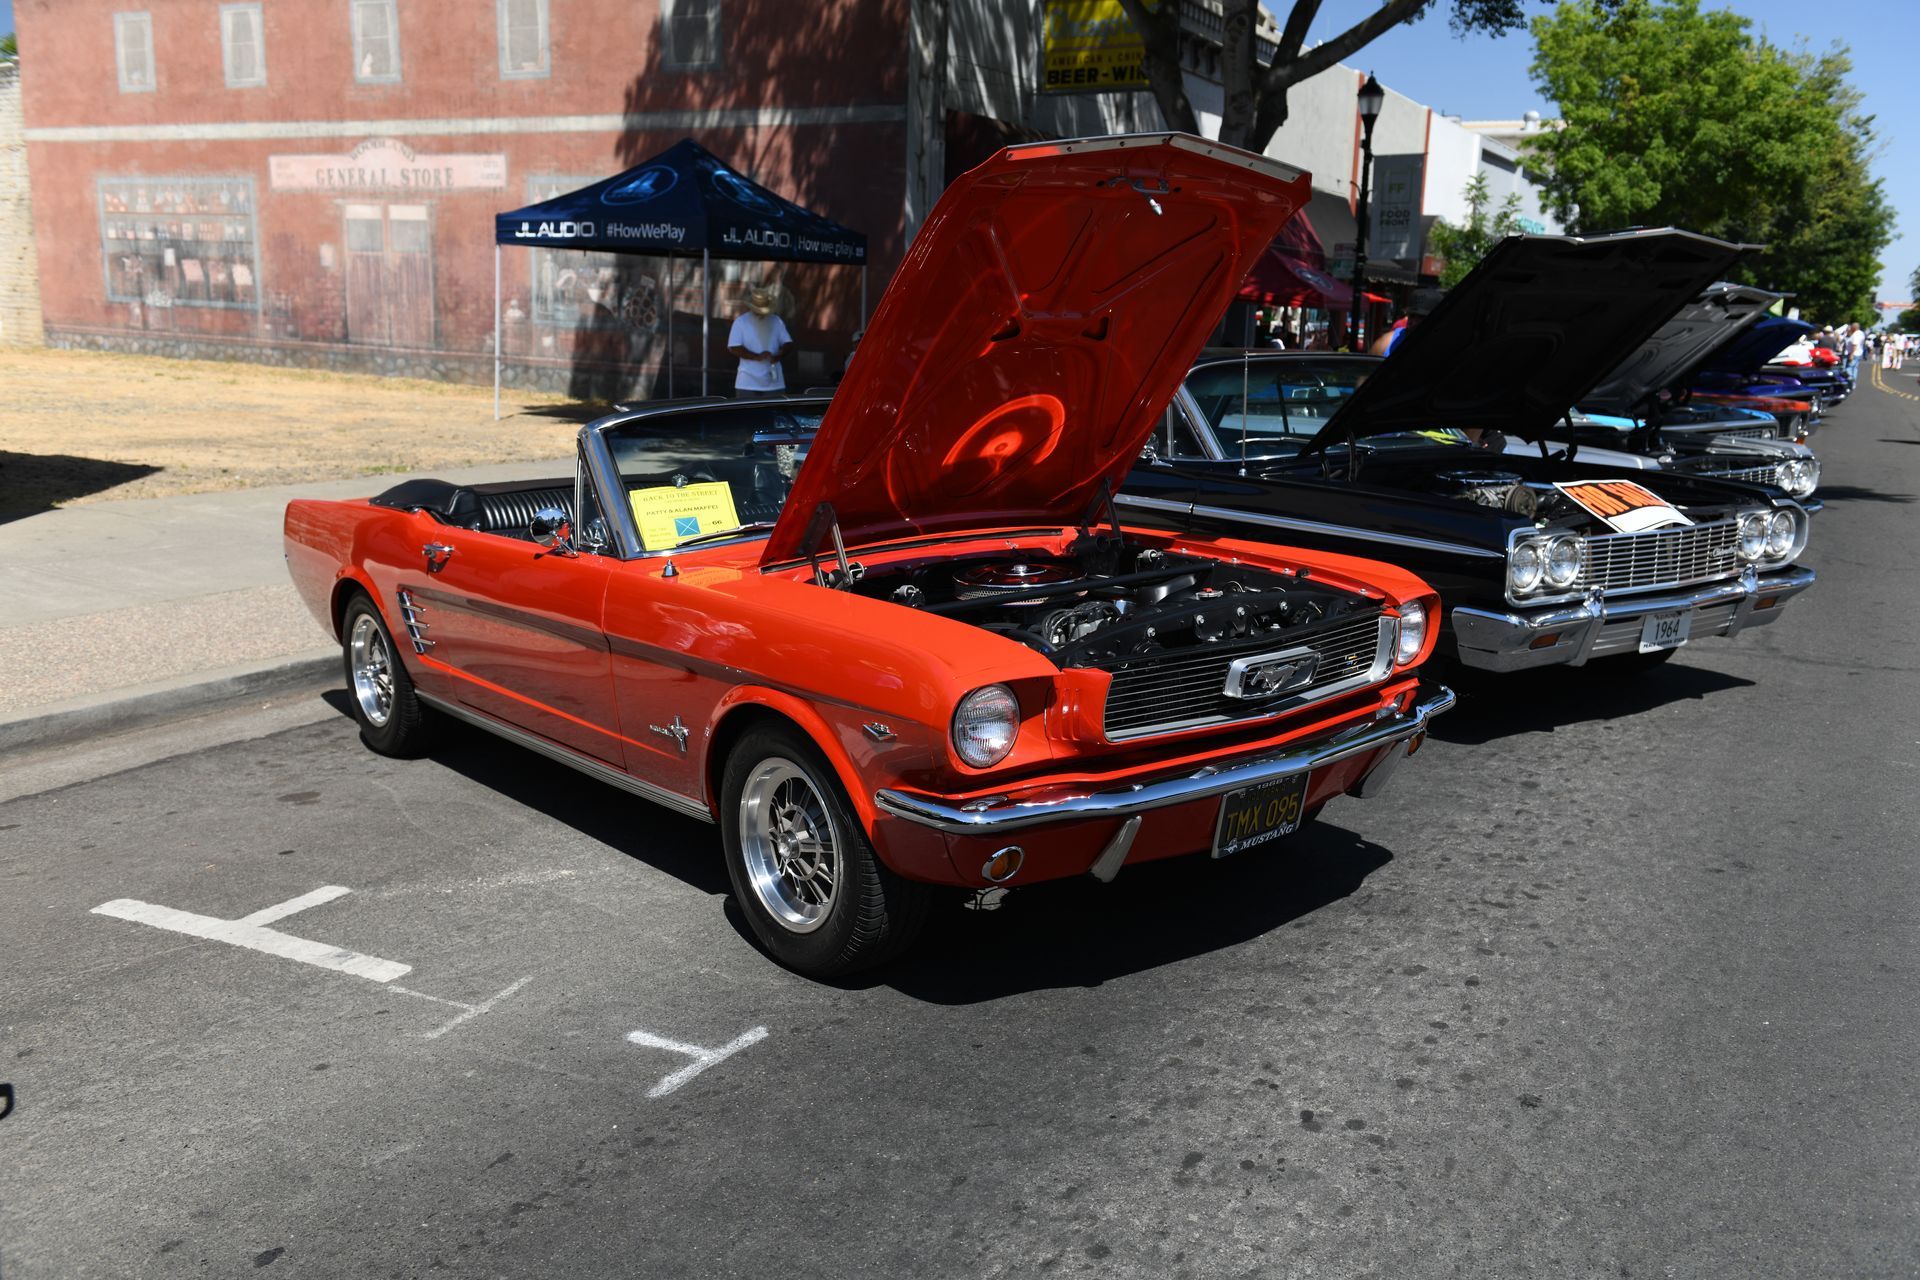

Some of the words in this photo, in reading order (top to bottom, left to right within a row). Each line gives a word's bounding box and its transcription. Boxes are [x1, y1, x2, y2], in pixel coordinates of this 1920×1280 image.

[1047, 67, 1098, 85] BEER
[1112, 65, 1147, 82] WIN
[316, 167, 391, 187] GENERAL
[400, 167, 454, 187] STORE
[1380, 209, 1410, 218] FOOD
[1380, 219, 1410, 227] FRONT
[537, 221, 596, 238] AUDIO
[606, 222, 686, 243] #HowWePlay
[743, 228, 791, 248] AUDIO
[798, 235, 820, 252] How
[821, 242, 834, 254] we
[643, 494, 664, 502] BACK
[1655, 619, 1680, 640] 1964
[1227, 803, 1262, 841] TMX
[1265, 793, 1299, 827] 095
[1240, 823, 1294, 850] MUSTANG
